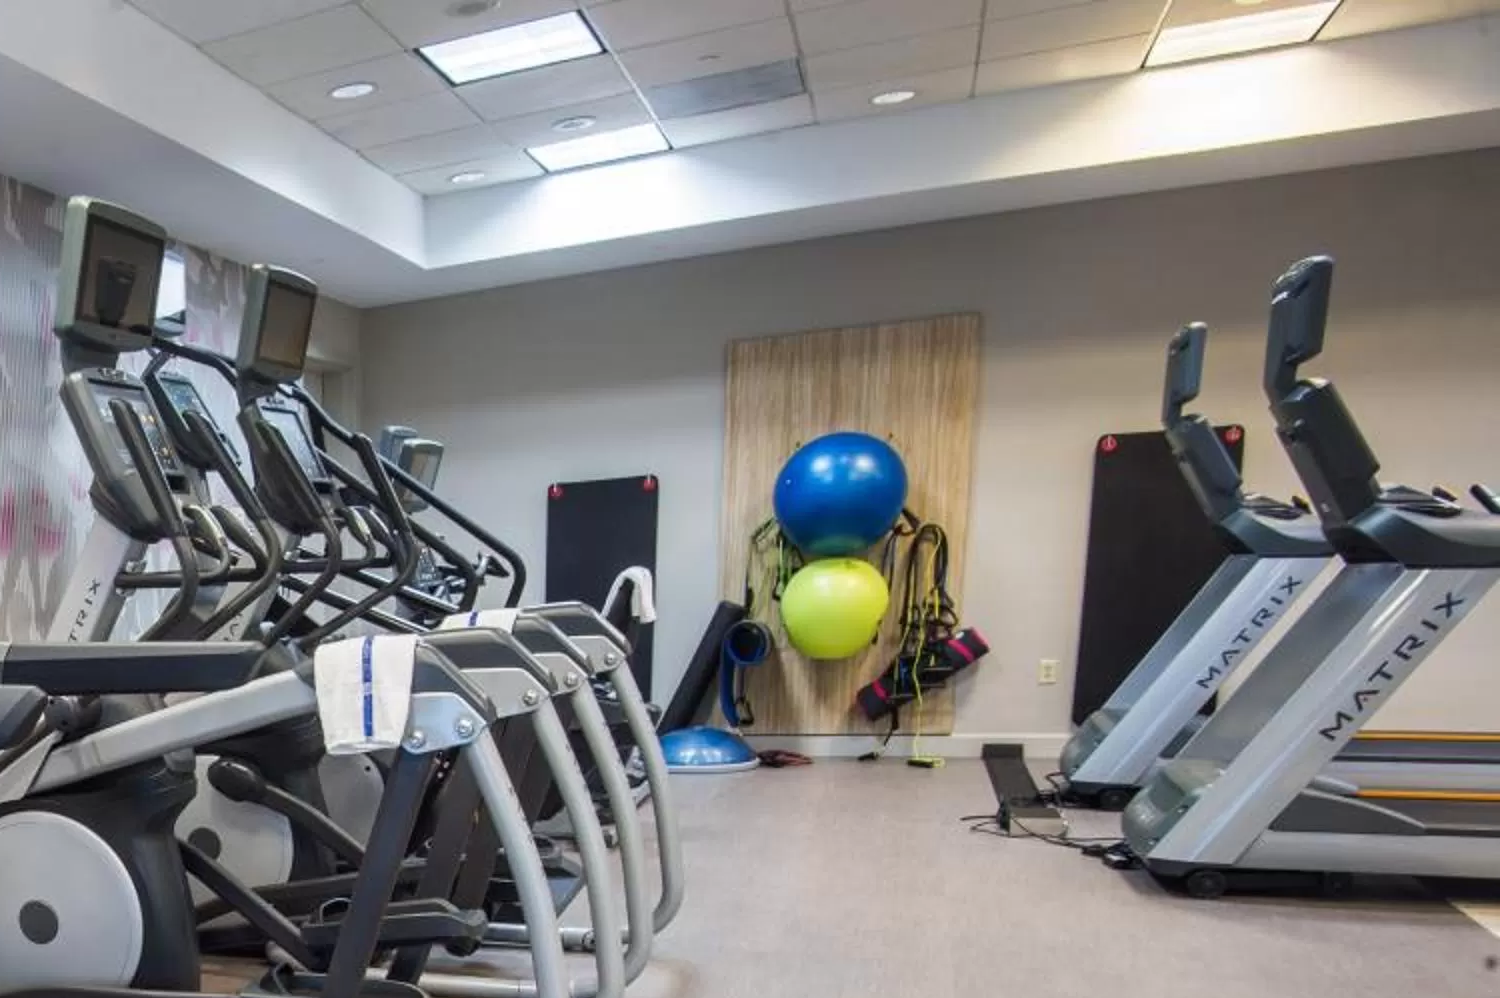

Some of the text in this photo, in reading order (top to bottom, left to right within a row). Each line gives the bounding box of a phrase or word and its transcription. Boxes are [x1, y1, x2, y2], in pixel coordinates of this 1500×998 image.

[68, 578, 101, 641] TRIX
[1195, 575, 1302, 689] MATRIX
[1318, 591, 1465, 741] MATRIX
